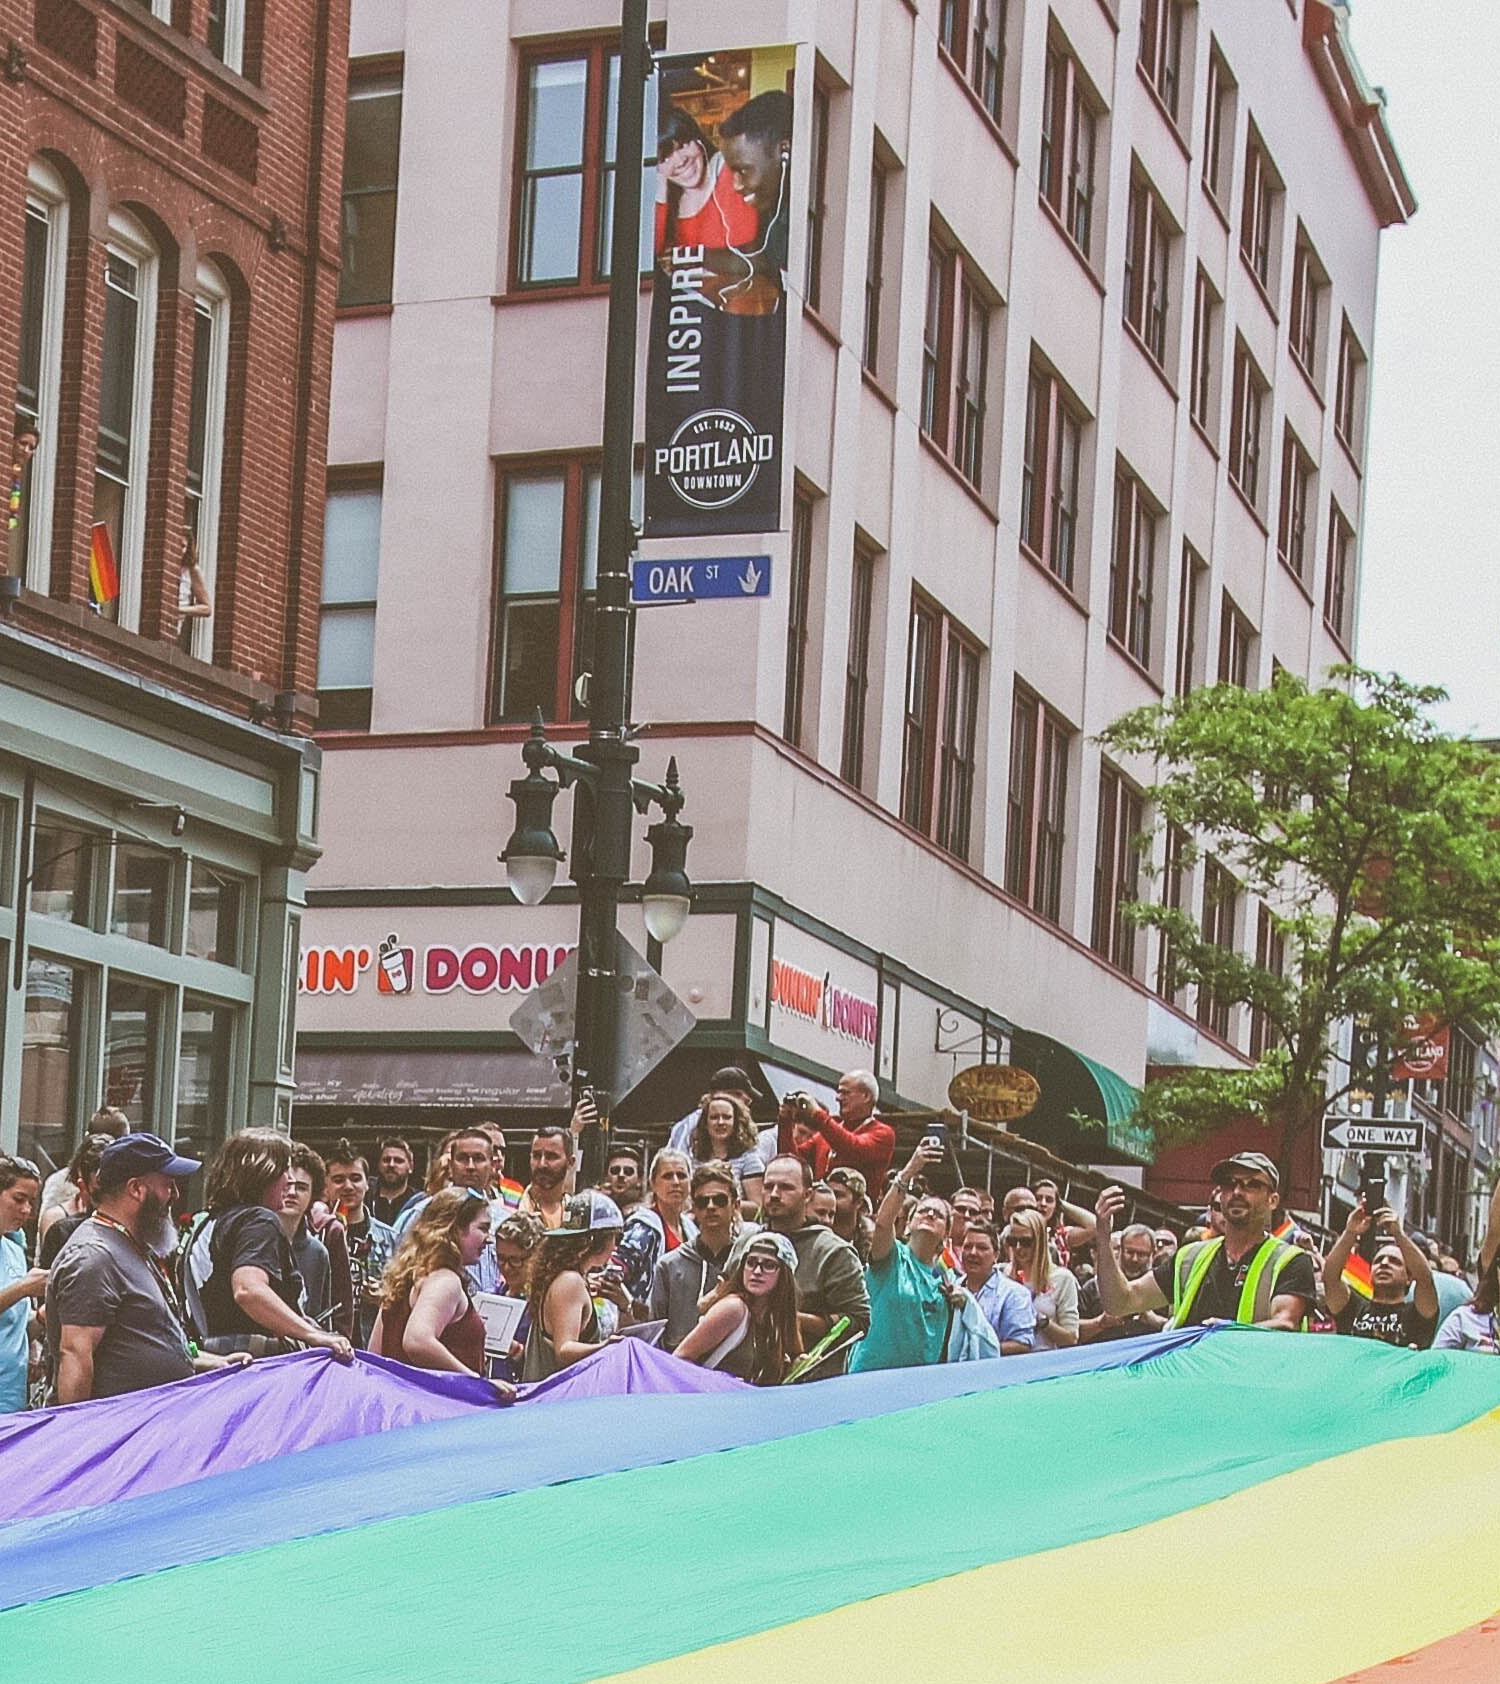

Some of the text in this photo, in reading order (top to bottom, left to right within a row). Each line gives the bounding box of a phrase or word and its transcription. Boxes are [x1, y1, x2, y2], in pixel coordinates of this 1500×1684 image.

[667, 244, 705, 392] INSPIRE
[693, 421, 712, 434] EST.
[655, 434, 774, 475] PORTLAND
[683, 474, 742, 490] DOWNTOWN
[649, 565, 720, 594] OAK ST
[299, 947, 578, 992] IN' DONU
[832, 988, 877, 1046] DONUTS
[1346, 1128, 1414, 1143] ONE WAY
